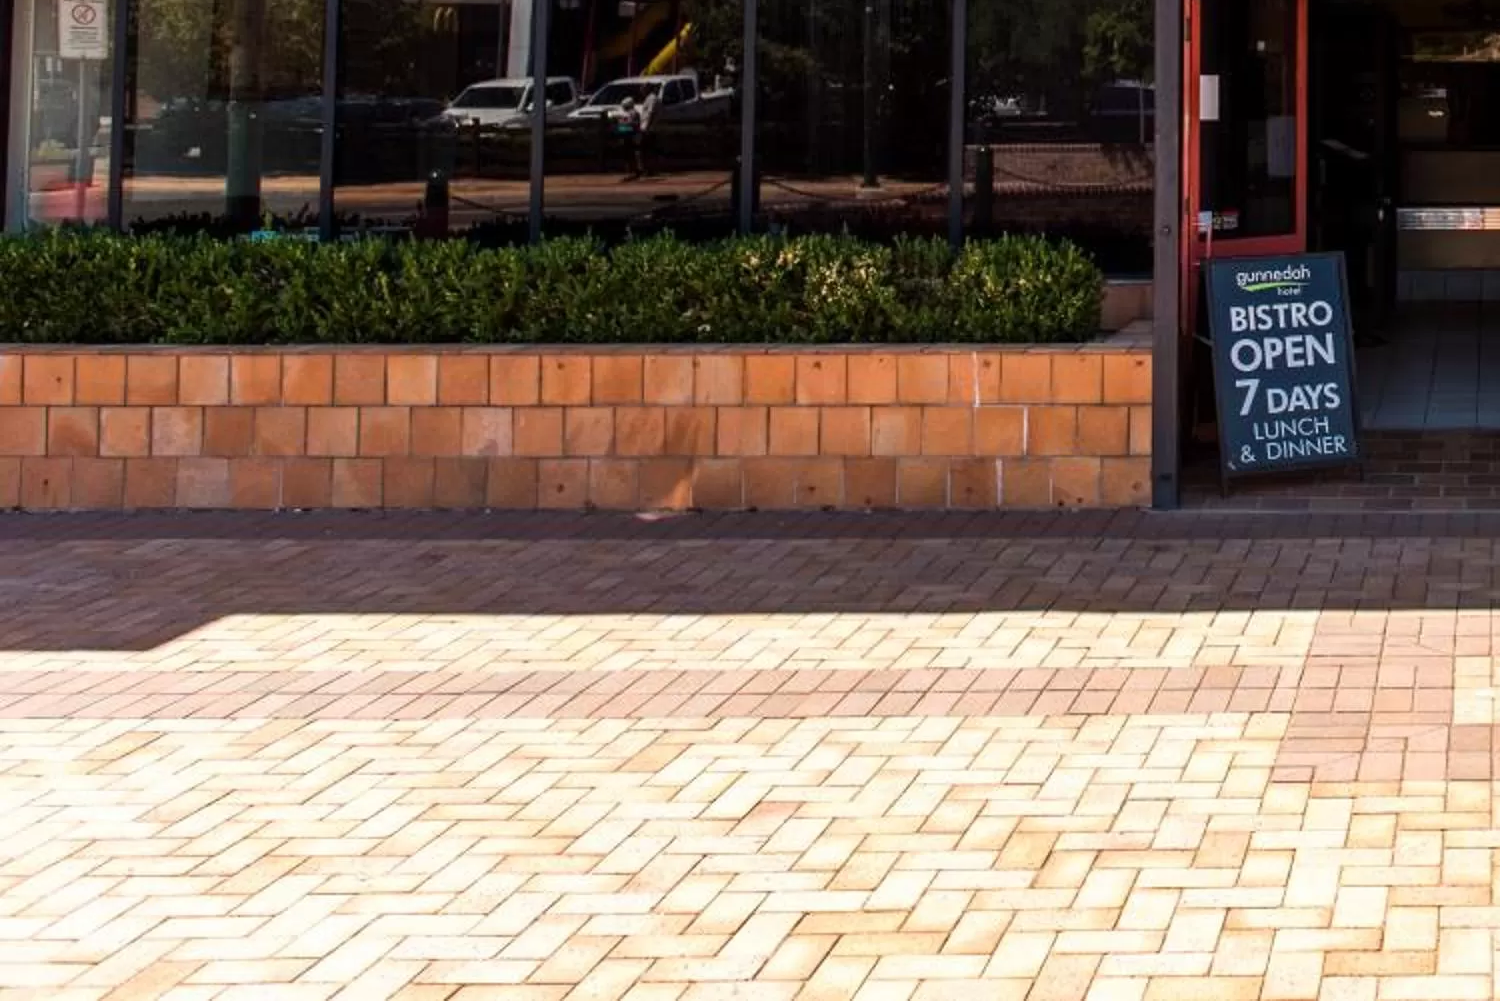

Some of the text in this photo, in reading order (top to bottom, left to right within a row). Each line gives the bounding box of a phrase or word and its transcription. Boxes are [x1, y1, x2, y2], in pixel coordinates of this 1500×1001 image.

[1235, 264, 1311, 287] gunnedah
[1277, 287, 1302, 296] hotel
[1229, 300, 1333, 332] BISTRO
[1230, 332, 1336, 372] OPEN
[1235, 378, 1341, 416] 7 DAYS
[1253, 416, 1329, 440] LUNCH
[1240, 435, 1348, 463] & DINNER
